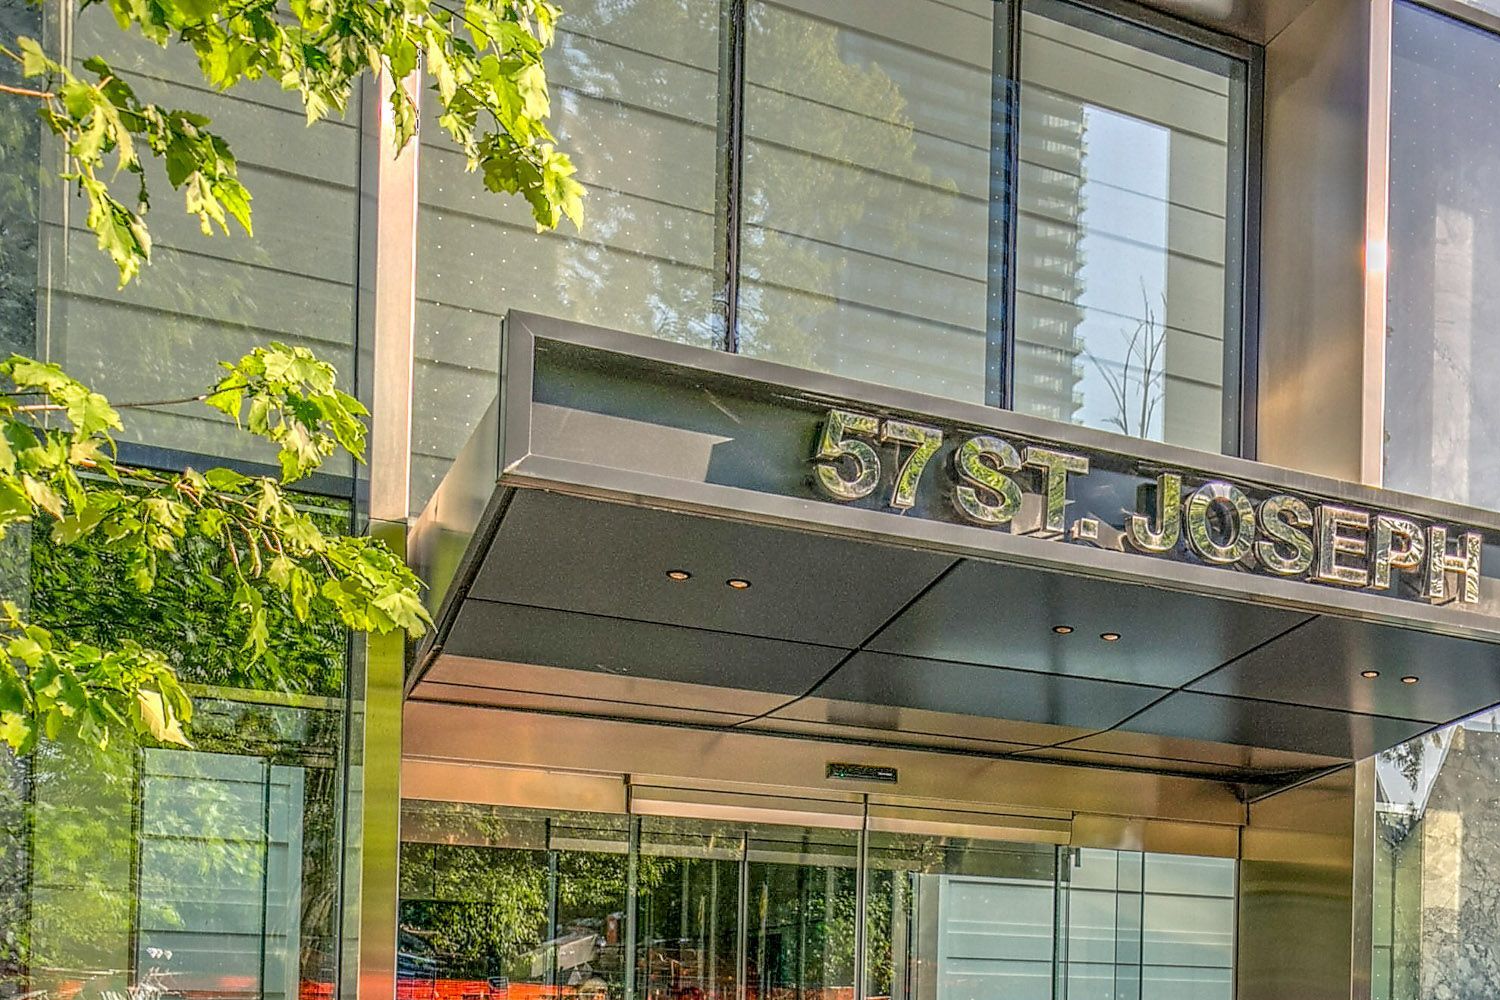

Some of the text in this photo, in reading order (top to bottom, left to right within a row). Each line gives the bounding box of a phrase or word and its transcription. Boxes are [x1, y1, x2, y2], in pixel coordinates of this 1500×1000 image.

[815, 408, 1485, 605] 57 ST. JOSEPH
